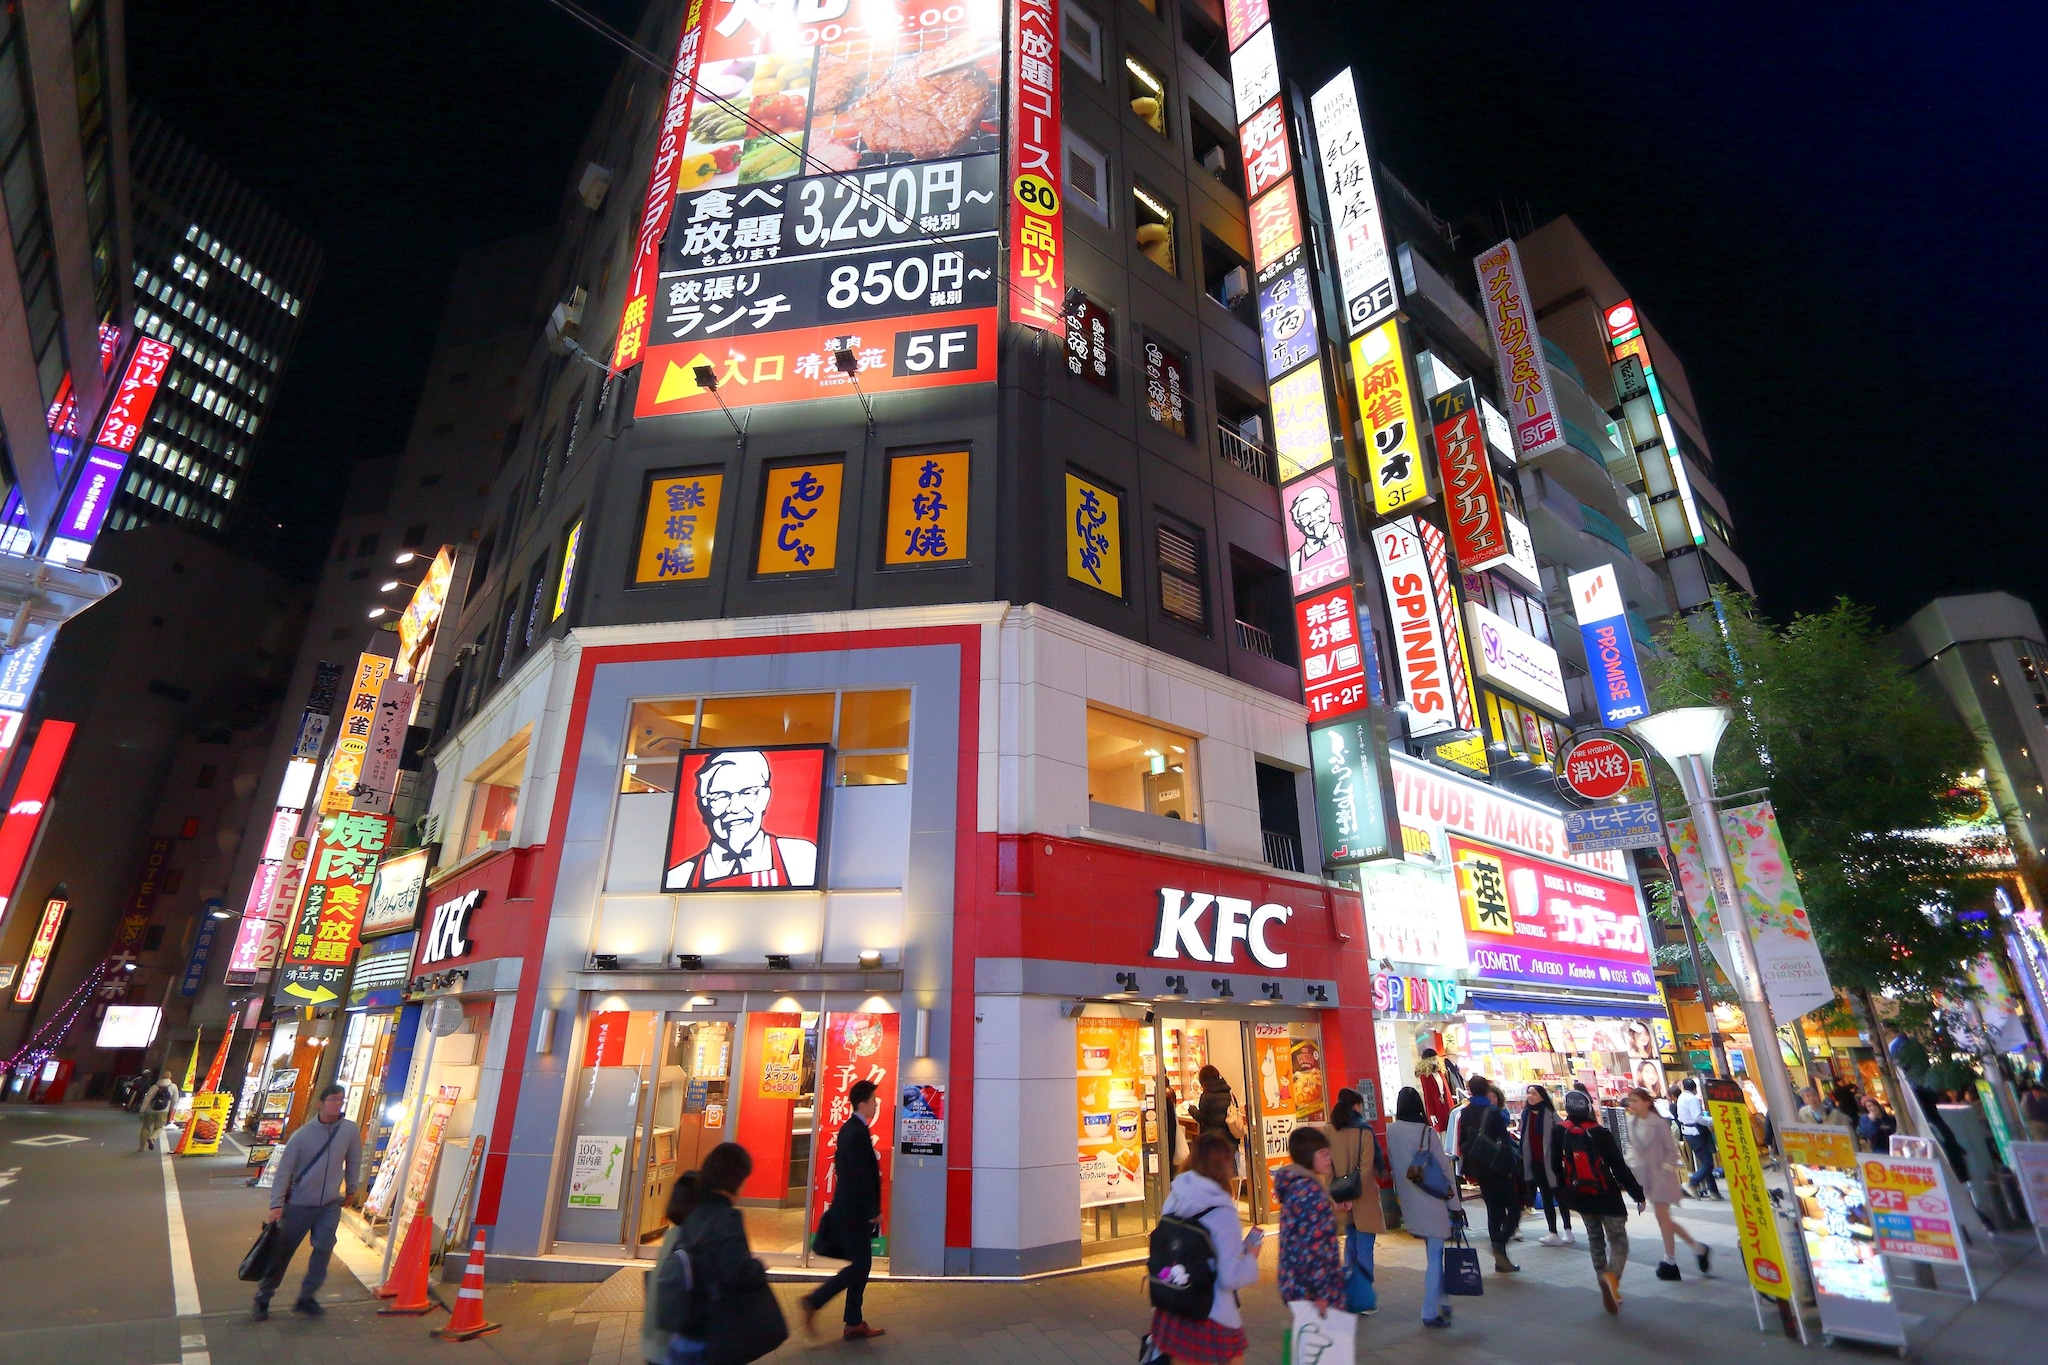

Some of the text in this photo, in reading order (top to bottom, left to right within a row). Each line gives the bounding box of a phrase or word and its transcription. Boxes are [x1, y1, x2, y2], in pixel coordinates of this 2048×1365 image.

[1242, 101, 1288, 198] 焼肉
[688, 184, 784, 224] 食べ
[1018, 182, 1055, 210] 80
[681, 211, 784, 257] 放題
[919, 212, 961, 235] 税別
[701, 245, 782, 267] もあります
[1020, 218, 1058, 326] 品以上
[668, 272, 761, 307] 欲張り
[930, 287, 963, 307] 税別
[1352, 283, 1393, 322] 6F
[666, 293, 791, 340] ランチ
[824, 335, 862, 352] 焼肉
[905, 331, 968, 372] 5F
[1281, 345, 1309, 369] 4F
[142, 346, 170, 388] スリム
[717, 348, 786, 387] 入口
[99, 340, 160, 446] ビューティハウス
[1435, 392, 1467, 420] 7F
[118, 424, 138, 449] 8F
[1521, 419, 1554, 446] 5F
[1388, 483, 1413, 508] 3F
[1443, 413, 1498, 551] イケメンカフェ
[777, 471, 825, 567] もんじゃ
[904, 459, 949, 557] お好焼
[657, 483, 706, 578] 鉄板焼
[1384, 533, 1411, 562] 2F
[1298, 559, 1347, 593] KFC
[1306, 597, 1349, 628] 完全
[1309, 619, 1352, 651] 分煙
[1392, 572, 1445, 714] SPINNS
[359, 664, 373, 689] セット
[375, 661, 387, 687] フリー
[1596, 625, 1632, 701] PROMISE
[348, 692, 378, 737] 麻雀
[1606, 704, 1644, 722] プロミス
[1572, 743, 1615, 759] FIRE HYDRANT
[1571, 754, 1627, 784] 消火栓
[363, 790, 382, 806] 2F
[1485, 805, 1555, 854] MAKES
[322, 811, 388, 886] 焼肉
[136, 839, 169, 910] HOTEL
[1543, 874, 1565, 891] DRUG
[1475, 860, 1508, 927] 薬
[41, 903, 61, 941] HOTEL
[311, 884, 363, 962] 食べ放題
[421, 888, 480, 965] KFC
[1152, 886, 1292, 970] KFC
[1514, 921, 1547, 939] SUNDRUG
[322, 968, 344, 983] 5F
[1475, 949, 1524, 974] COSMETIC
[1569, 962, 1596, 980] Kanebo
[1374, 973, 1459, 1014] SPINNS
[1256, 1025, 1289, 1036] ケンタッキー
[764, 1072, 800, 1082] メイプル
[765, 1063, 790, 1072] ハニー
[1266, 1119, 1293, 1136] ムーミン
[579, 1144, 603, 1156] 100%
[1889, 1164, 1933, 1176] SPINNS
[1870, 1188, 1904, 1209] 2F
